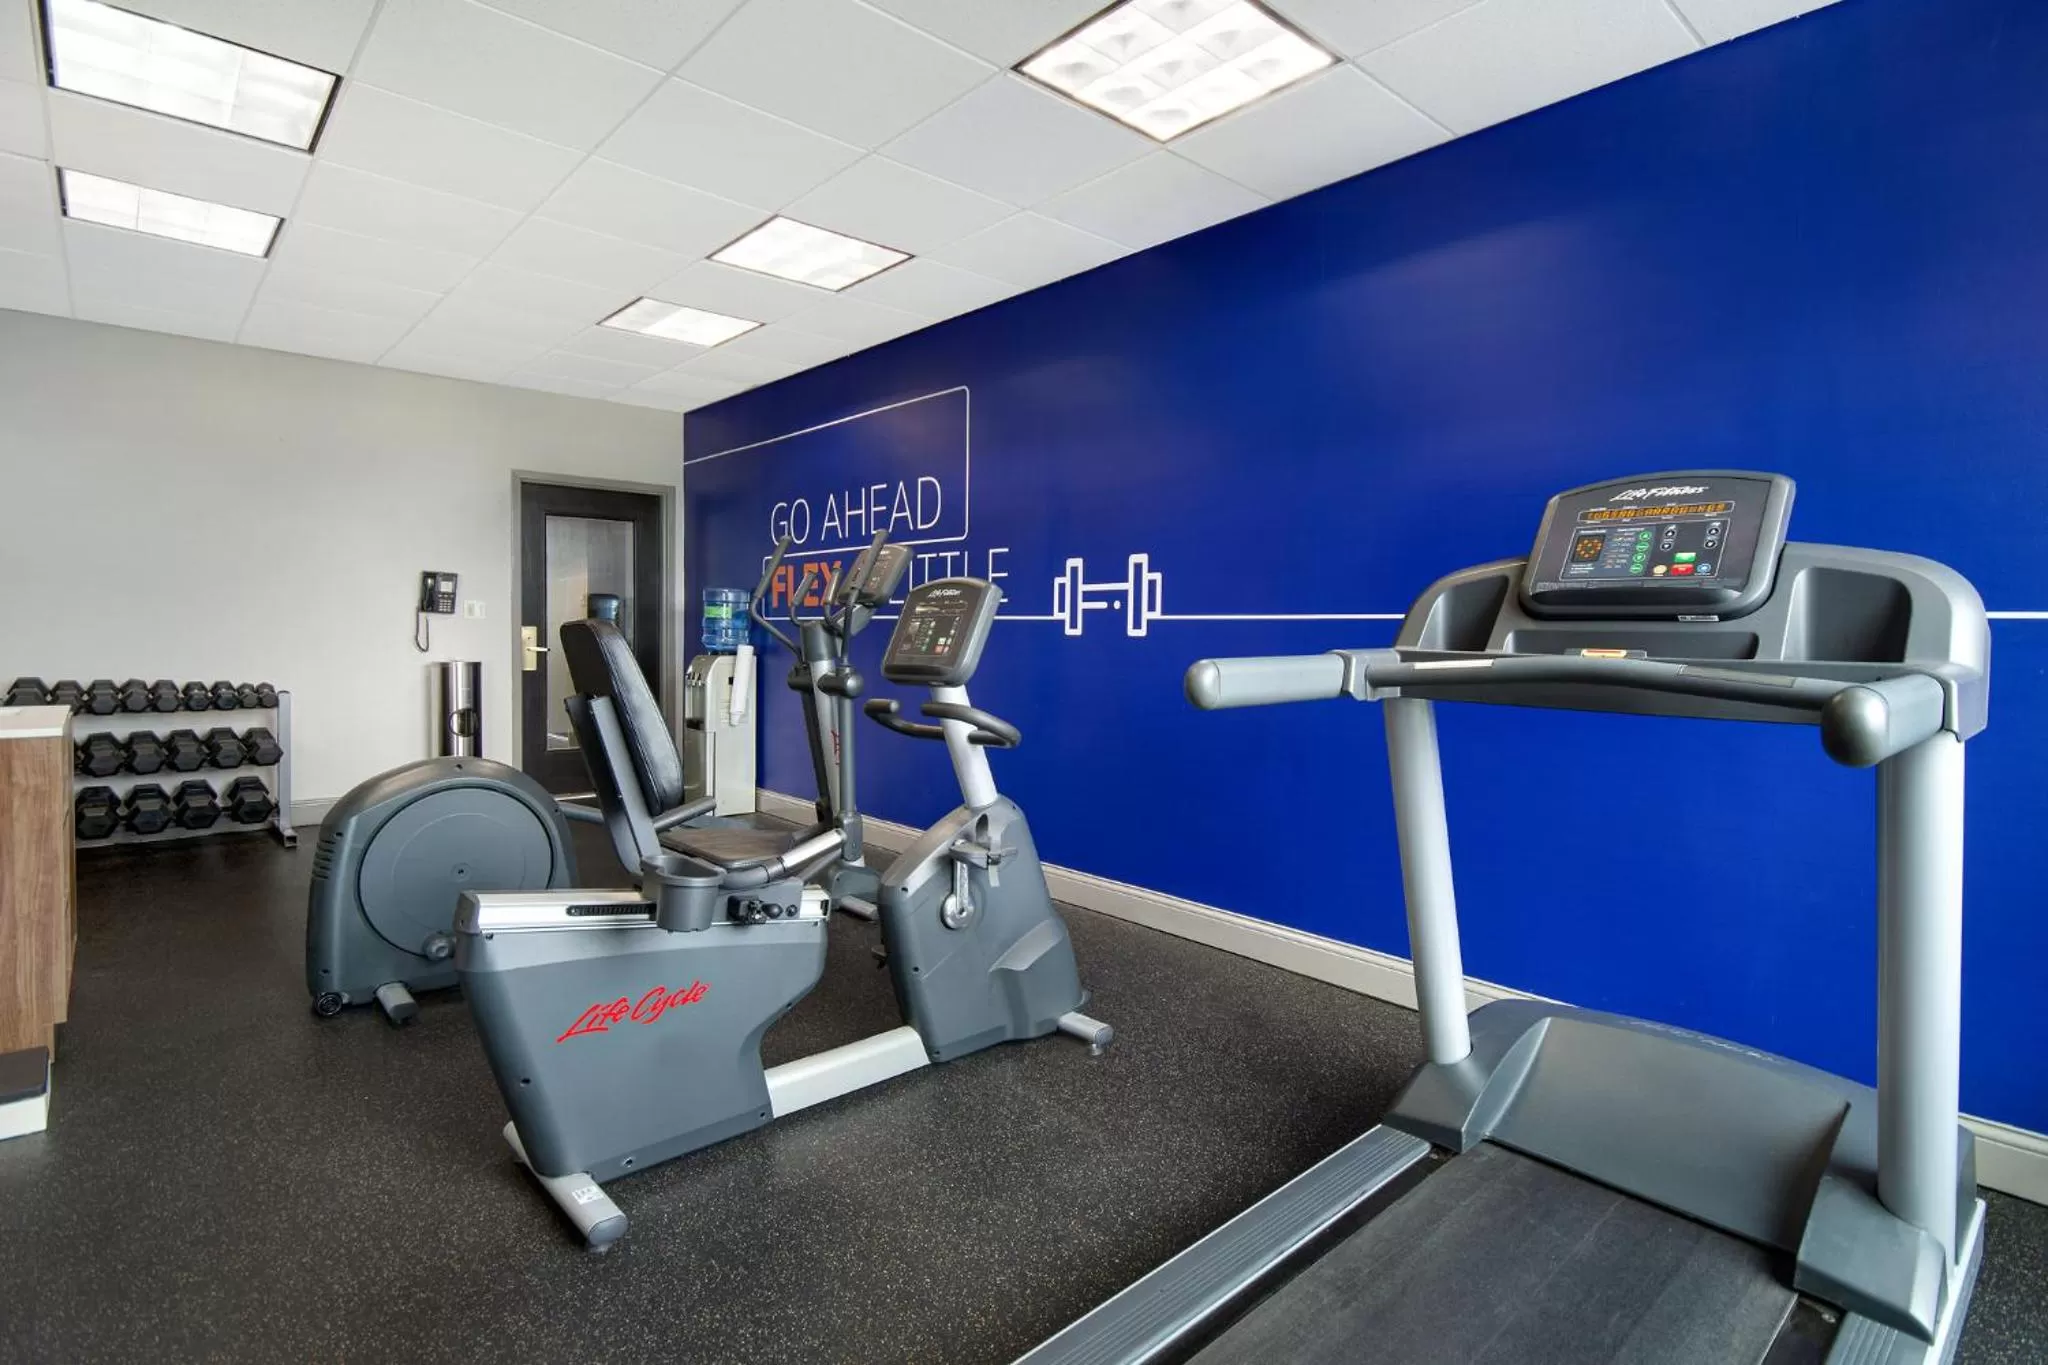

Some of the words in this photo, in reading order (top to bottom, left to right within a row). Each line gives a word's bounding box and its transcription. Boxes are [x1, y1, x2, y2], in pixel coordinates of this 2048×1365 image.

[770, 499, 810, 546] GO
[821, 476, 941, 541] AHEAD
[772, 561, 842, 608] FLEX
[556, 996, 630, 1043] Life
[631, 981, 712, 1025] Cycle
